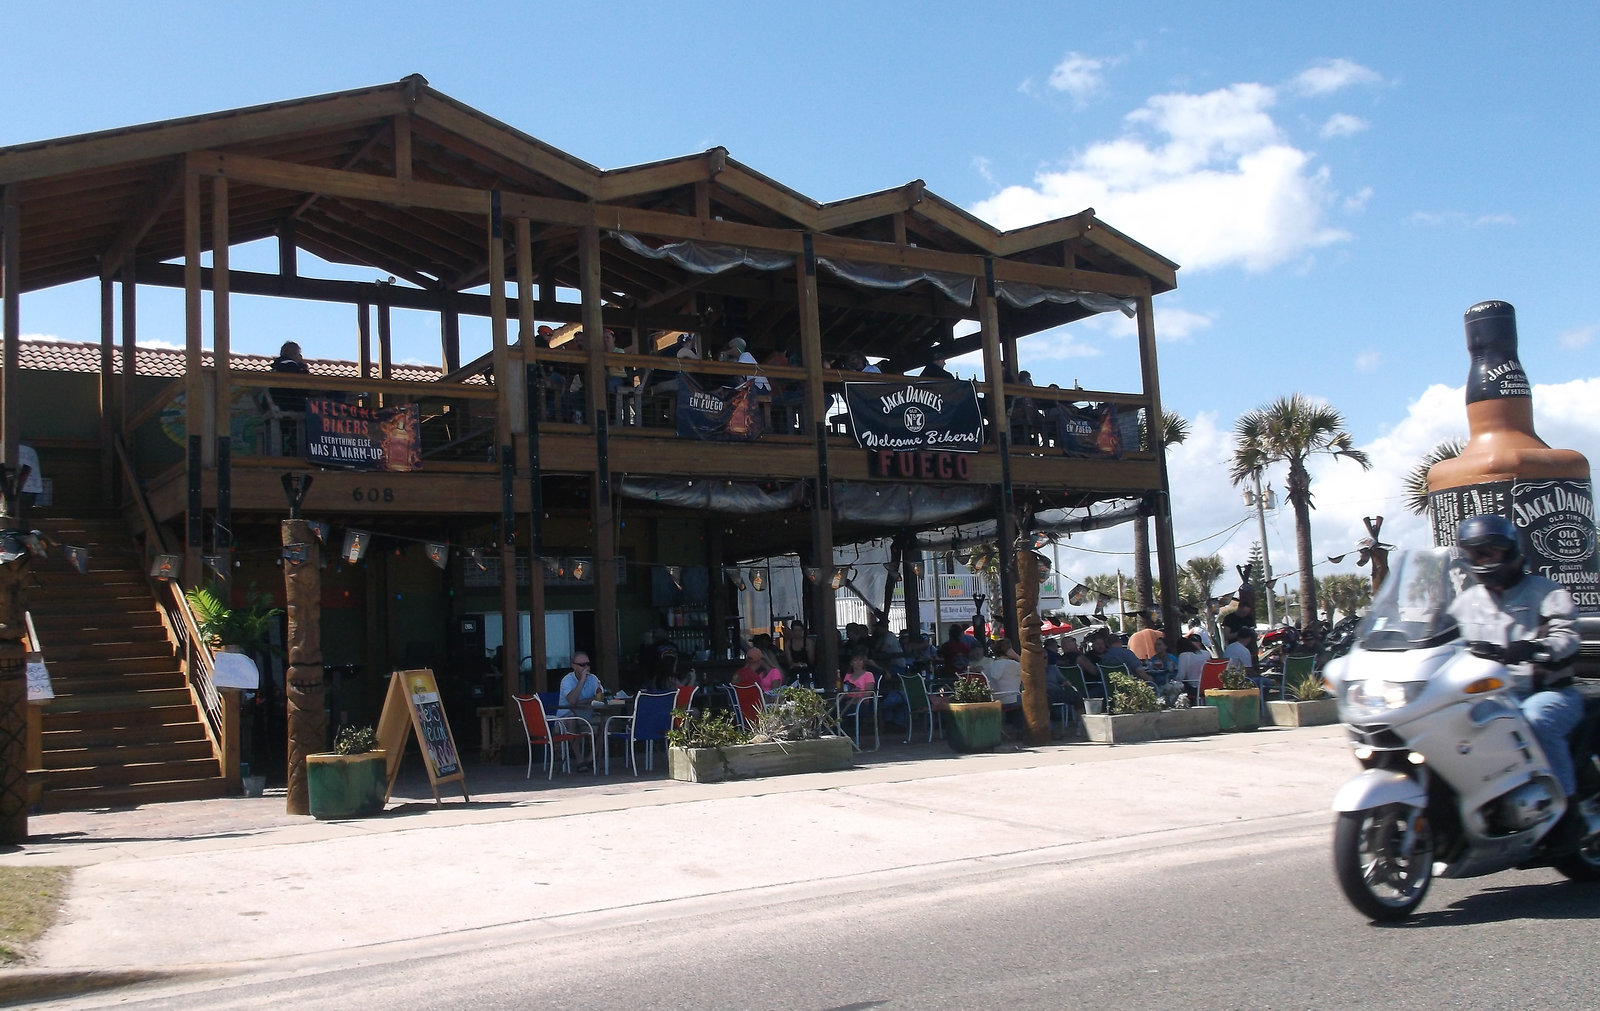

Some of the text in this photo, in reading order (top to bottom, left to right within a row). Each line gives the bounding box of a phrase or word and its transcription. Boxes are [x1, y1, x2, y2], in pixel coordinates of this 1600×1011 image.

[1488, 363, 1510, 382] JACK
[689, 397, 698, 408] EN
[701, 399, 724, 411] FUEGO
[880, 386, 944, 414] JACK DANIEL'S
[310, 400, 378, 419] WELCOME
[323, 417, 368, 434] BIKERS
[321, 436, 371, 447] EVERYTHING ELSE
[862, 428, 980, 447] Welcome Bikers!
[310, 443, 383, 460] WAS A WARM-UP
[879, 450, 970, 480] FUEGO
[352, 487, 394, 502] 608
[1512, 487, 1594, 528] JACK DANIEL
[1549, 514, 1582, 523] OLD TIME
[1539, 566, 1599, 584] Tennessee
